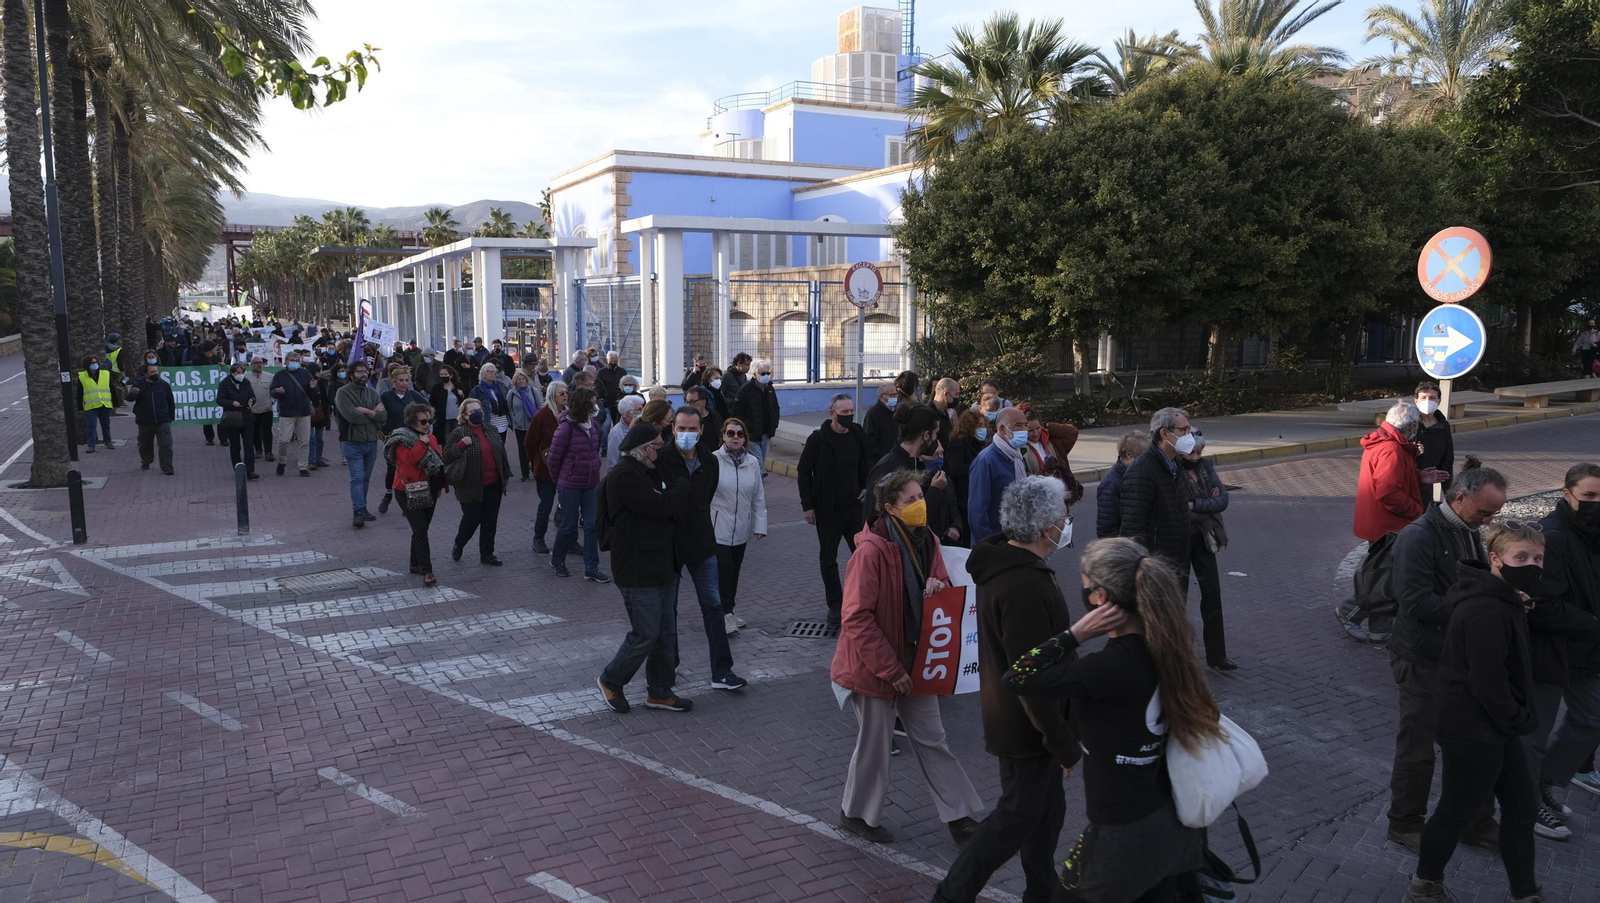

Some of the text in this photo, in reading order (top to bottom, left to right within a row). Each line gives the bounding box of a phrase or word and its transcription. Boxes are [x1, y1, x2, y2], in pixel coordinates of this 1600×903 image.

[852, 262, 877, 272] EXCEPTO
[1422, 281, 1481, 300] AMBOS LADOS
[173, 388, 218, 404] mbie
[174, 405, 224, 421] ultura
[922, 607, 953, 681] STOP
